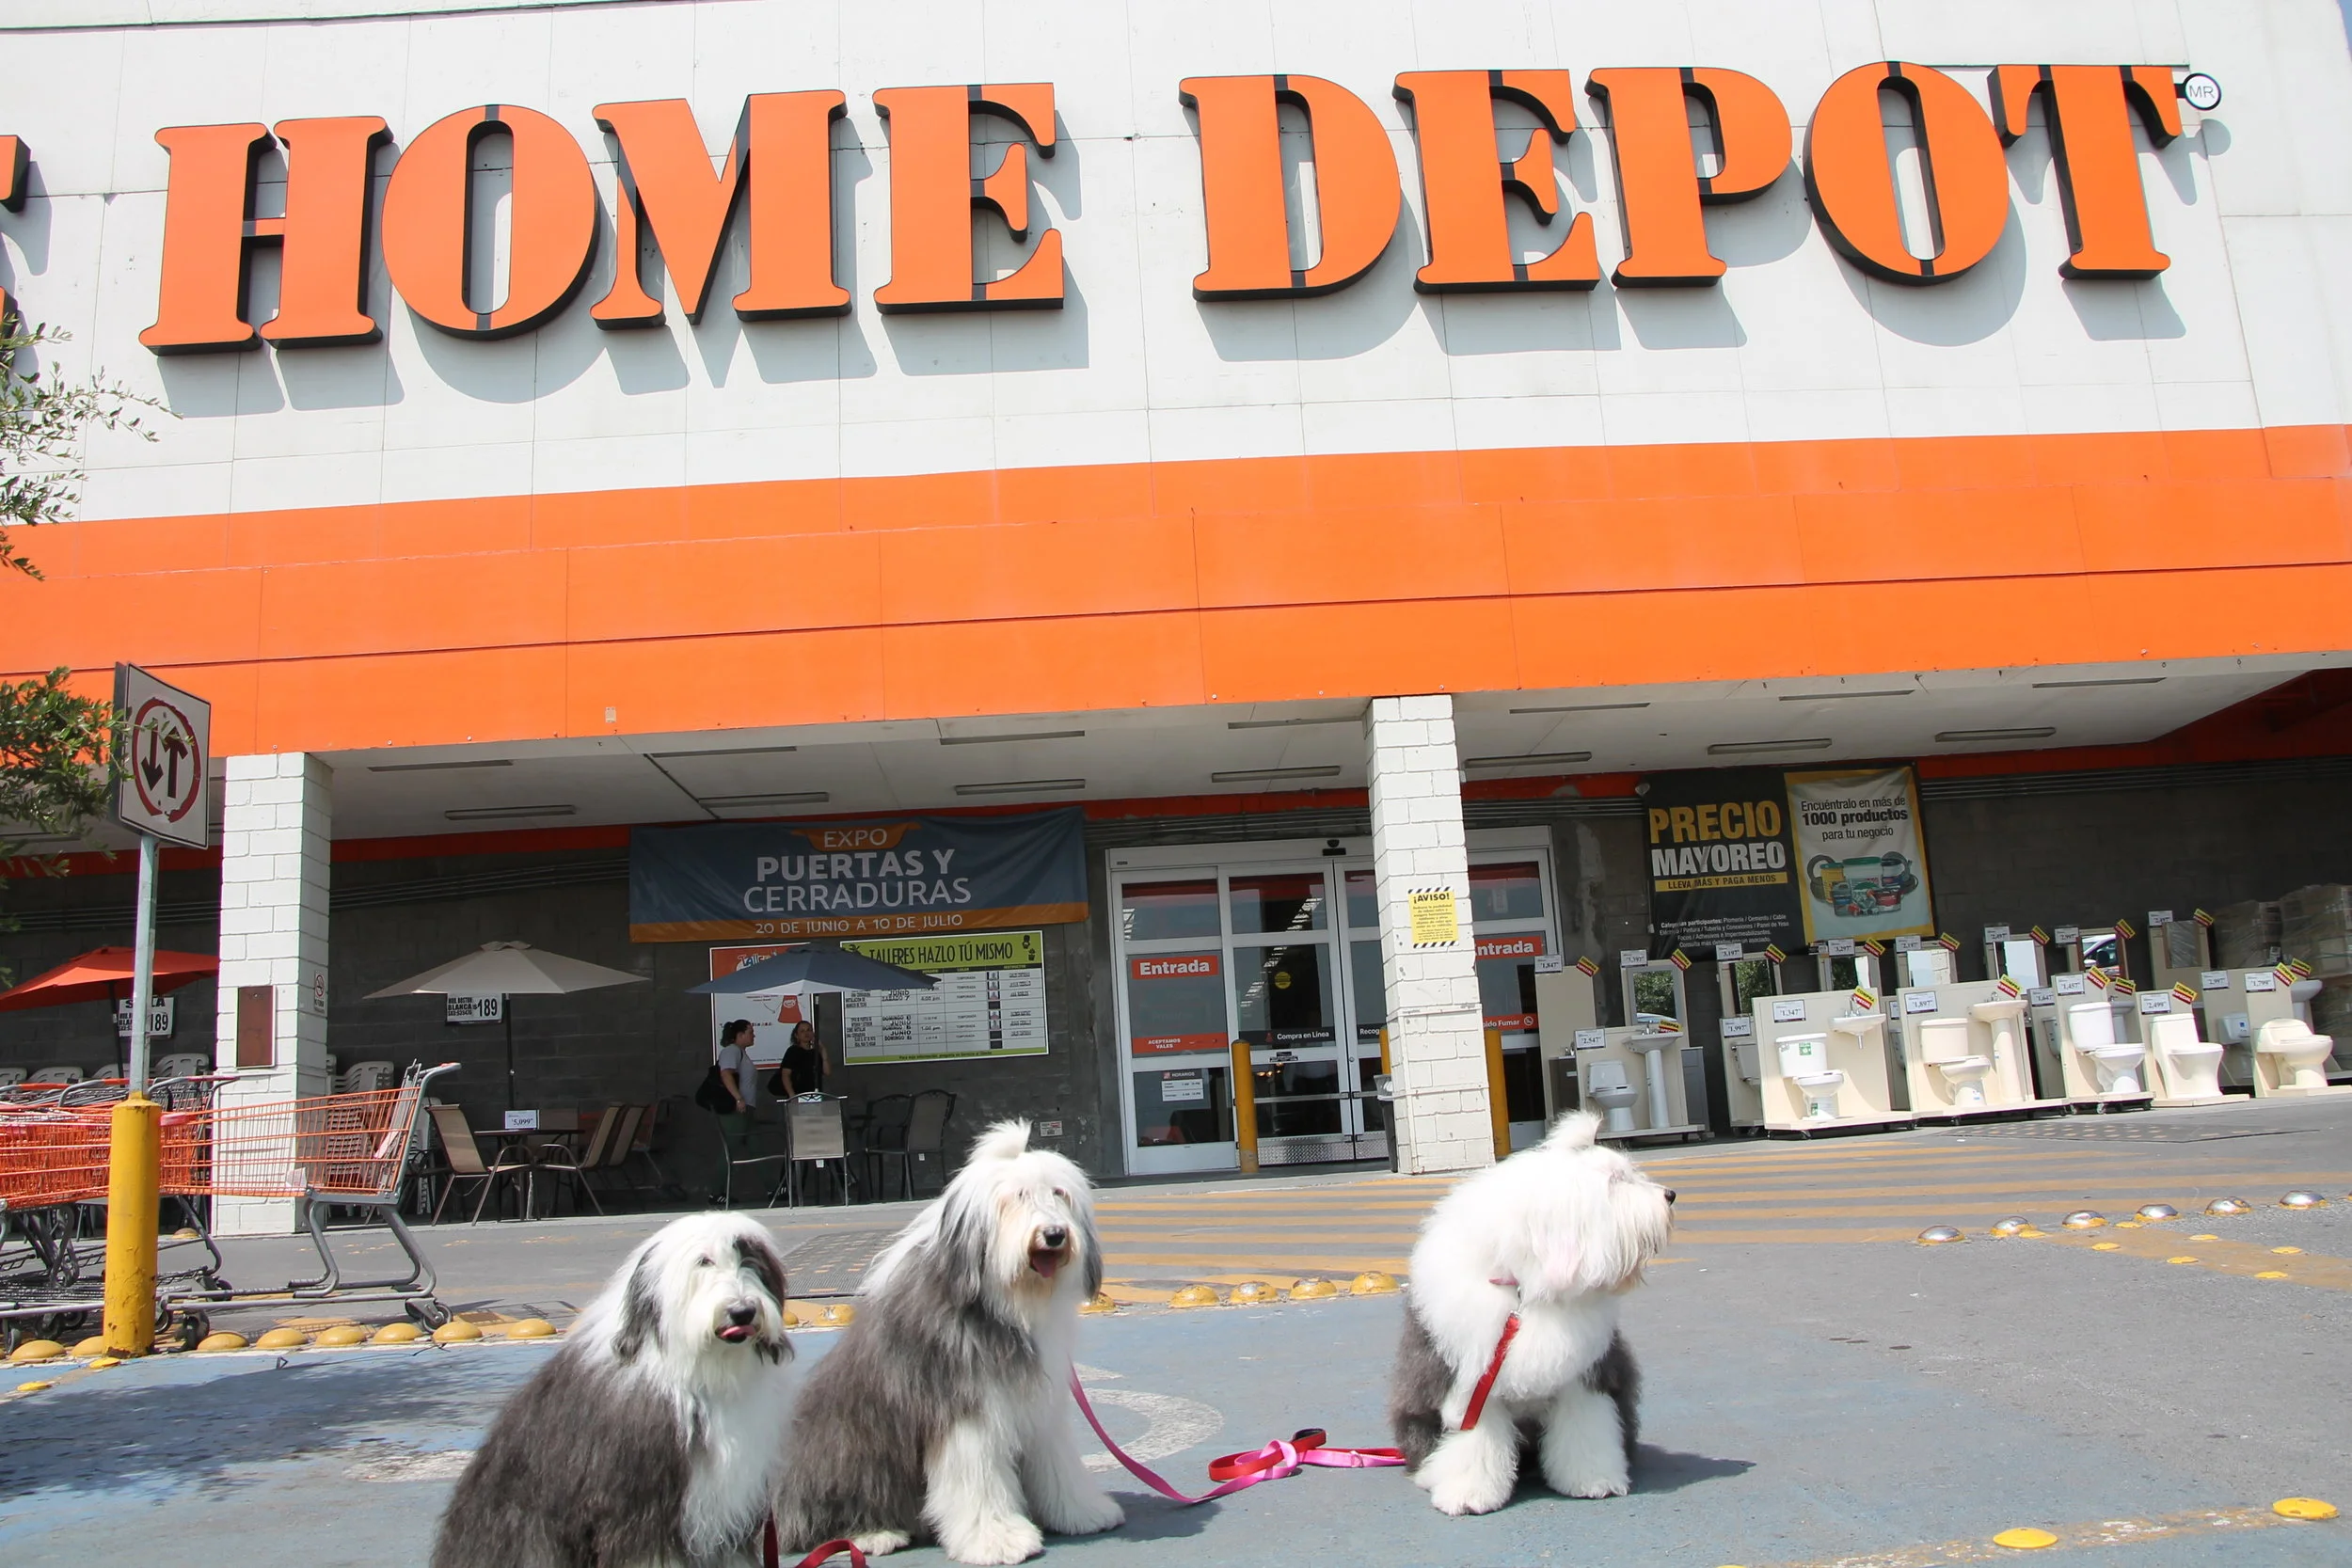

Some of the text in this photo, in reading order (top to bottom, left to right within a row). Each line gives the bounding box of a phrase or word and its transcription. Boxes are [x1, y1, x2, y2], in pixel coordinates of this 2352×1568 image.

[2188, 85, 2216, 99] MR
[138, 82, 1064, 356] HOME
[1178, 61, 2182, 302] DEPOT
[1801, 796, 1906, 812] Encuéntralo en más de
[1648, 800, 1781, 844] PRECIO
[1803, 808, 1908, 826] 1000 productos
[824, 828, 887, 847] EXPO
[1821, 826, 1894, 842] para tu negocio
[757, 848, 955, 882] PUERTAS Y
[1651, 841, 1786, 877] MAYOREO
[1667, 875, 1776, 890] LLEVA MÁS Y PAGA MENOS
[743, 878, 972, 912] CERRADURAS
[1413, 893, 1450, 904] ¡AVISO!
[755, 914, 962, 934] 20 DE JUNIO A 10 DE JULIO
[918, 946, 955, 964] HAZLO
[958, 941, 973, 961] TÚ
[976, 942, 1013, 960] MISMO
[1476, 941, 1534, 957] ntrada
[1139, 959, 1210, 975] Entrada
[125, 998, 166, 1009] SLA
[1855, 988, 1876, 1003] COMPRA
[151, 1013, 168, 1032] 189
[1277, 1032, 1303, 1041] Compra
[1359, 1028, 1380, 1037] Recog
